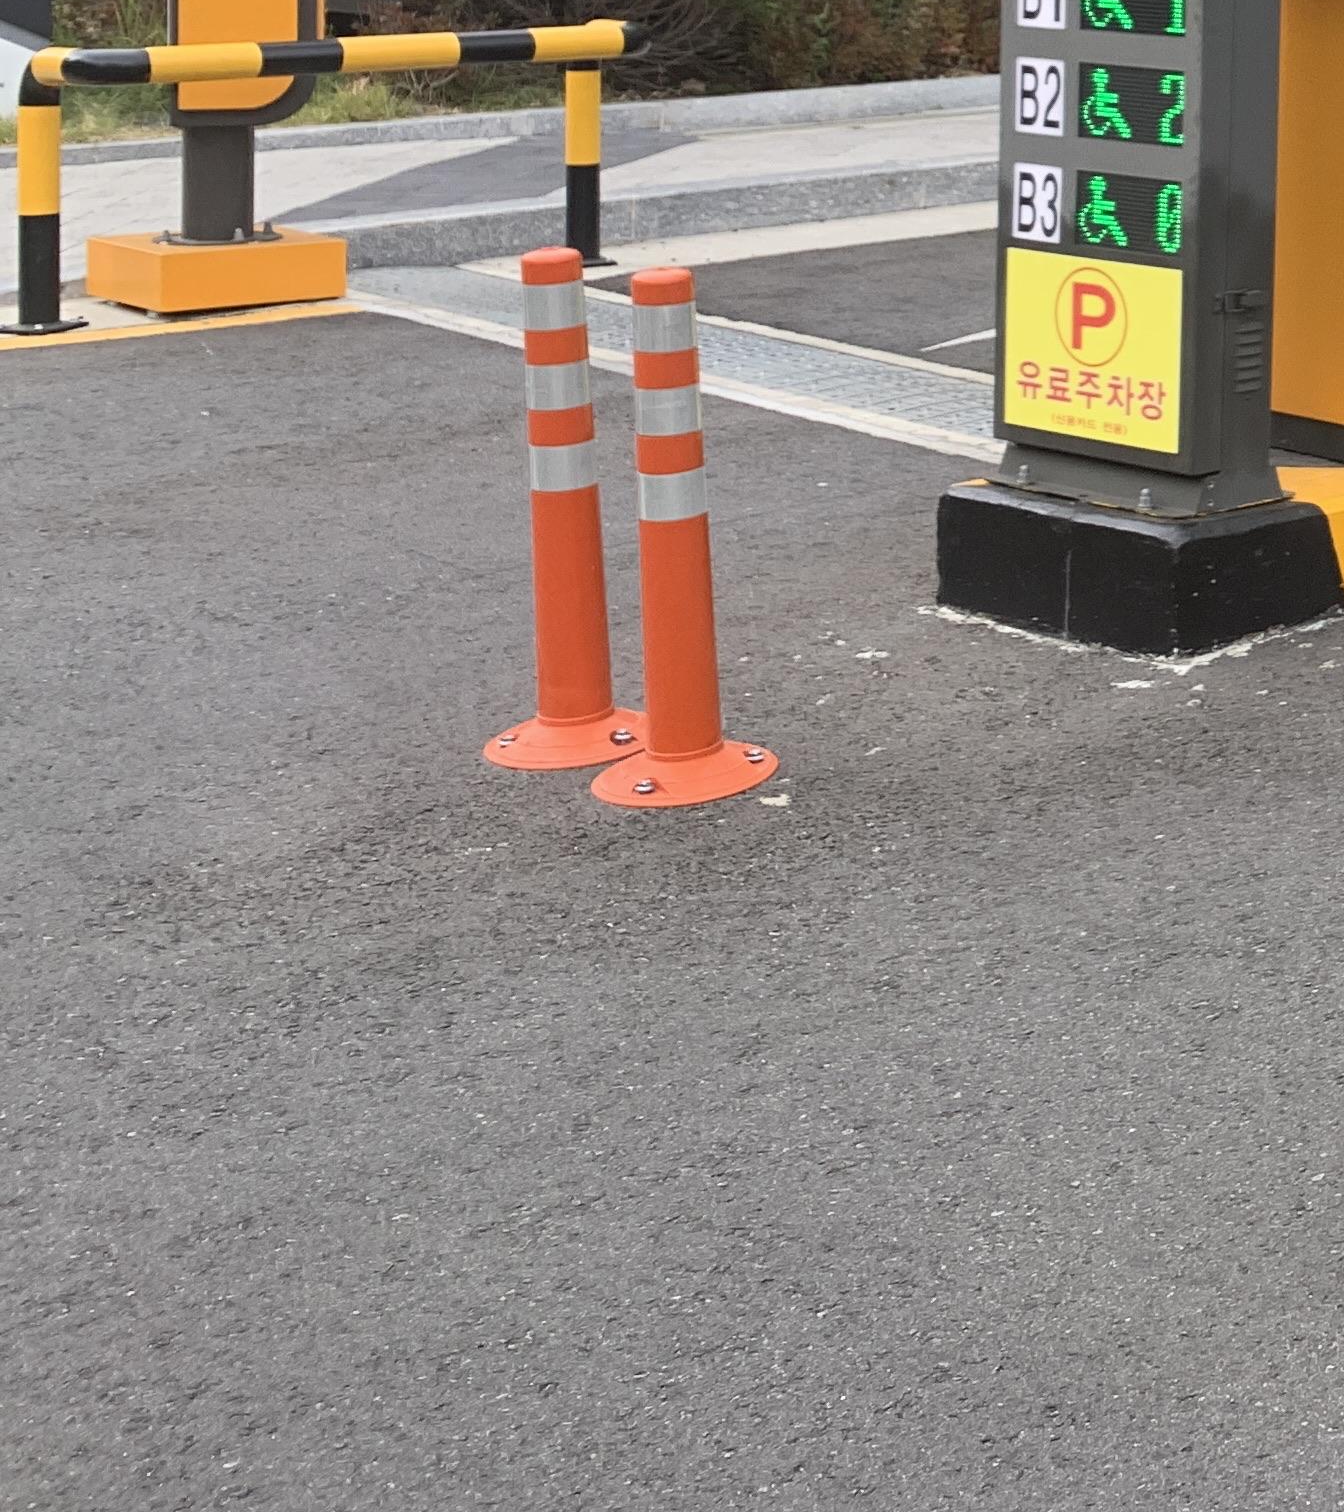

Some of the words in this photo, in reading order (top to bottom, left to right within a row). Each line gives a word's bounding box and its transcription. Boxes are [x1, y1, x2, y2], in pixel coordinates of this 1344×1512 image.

[1018, 65, 1062, 129] B2
[1159, 75, 1185, 145] 2
[1017, 172, 1060, 238] B3
[1072, 281, 1117, 351] P
[1016, 360, 1167, 420] 유료주차장
